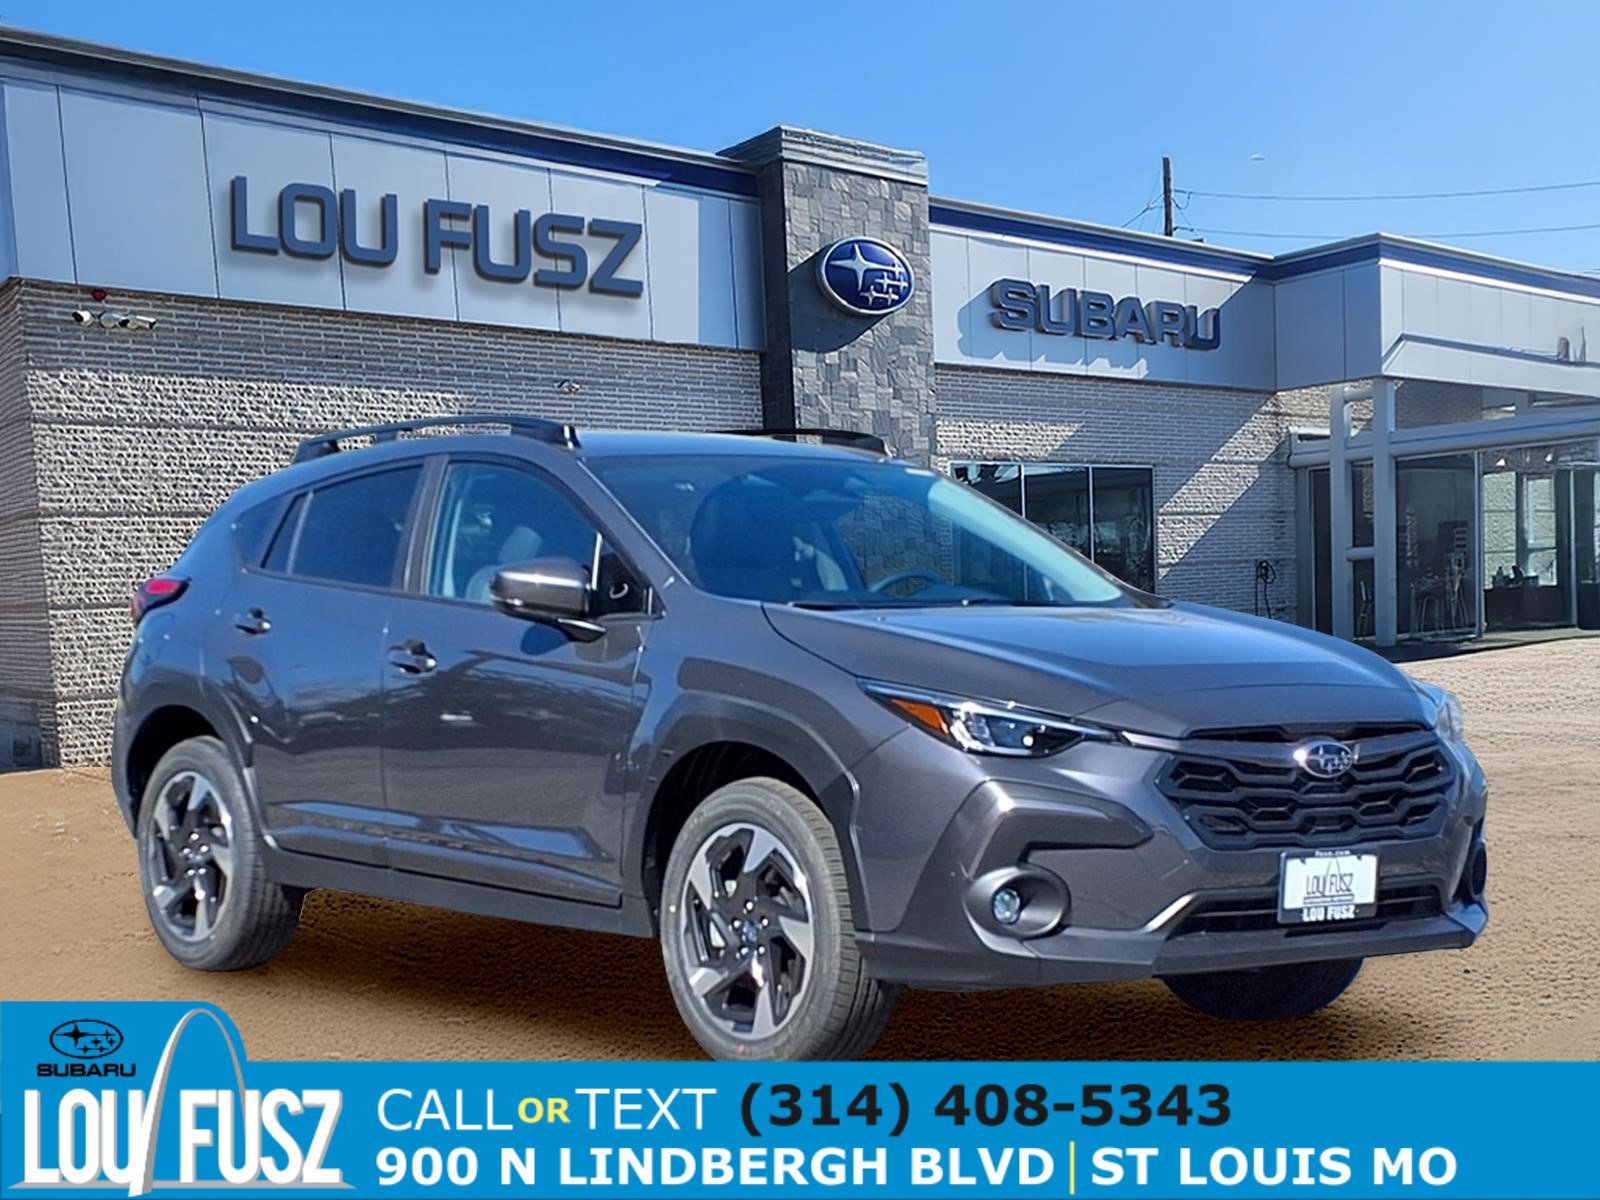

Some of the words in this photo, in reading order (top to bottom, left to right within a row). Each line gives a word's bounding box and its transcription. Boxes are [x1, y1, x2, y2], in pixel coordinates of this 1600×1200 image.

[231, 175, 398, 266] LOU
[425, 198, 643, 298] FUSZ
[990, 277, 1222, 351] SUBARU
[1306, 875, 1327, 896] LOU
[1328, 872, 1354, 894] FUSZ
[1302, 906, 1325, 922] LOU
[1327, 904, 1355, 920] FUSZ
